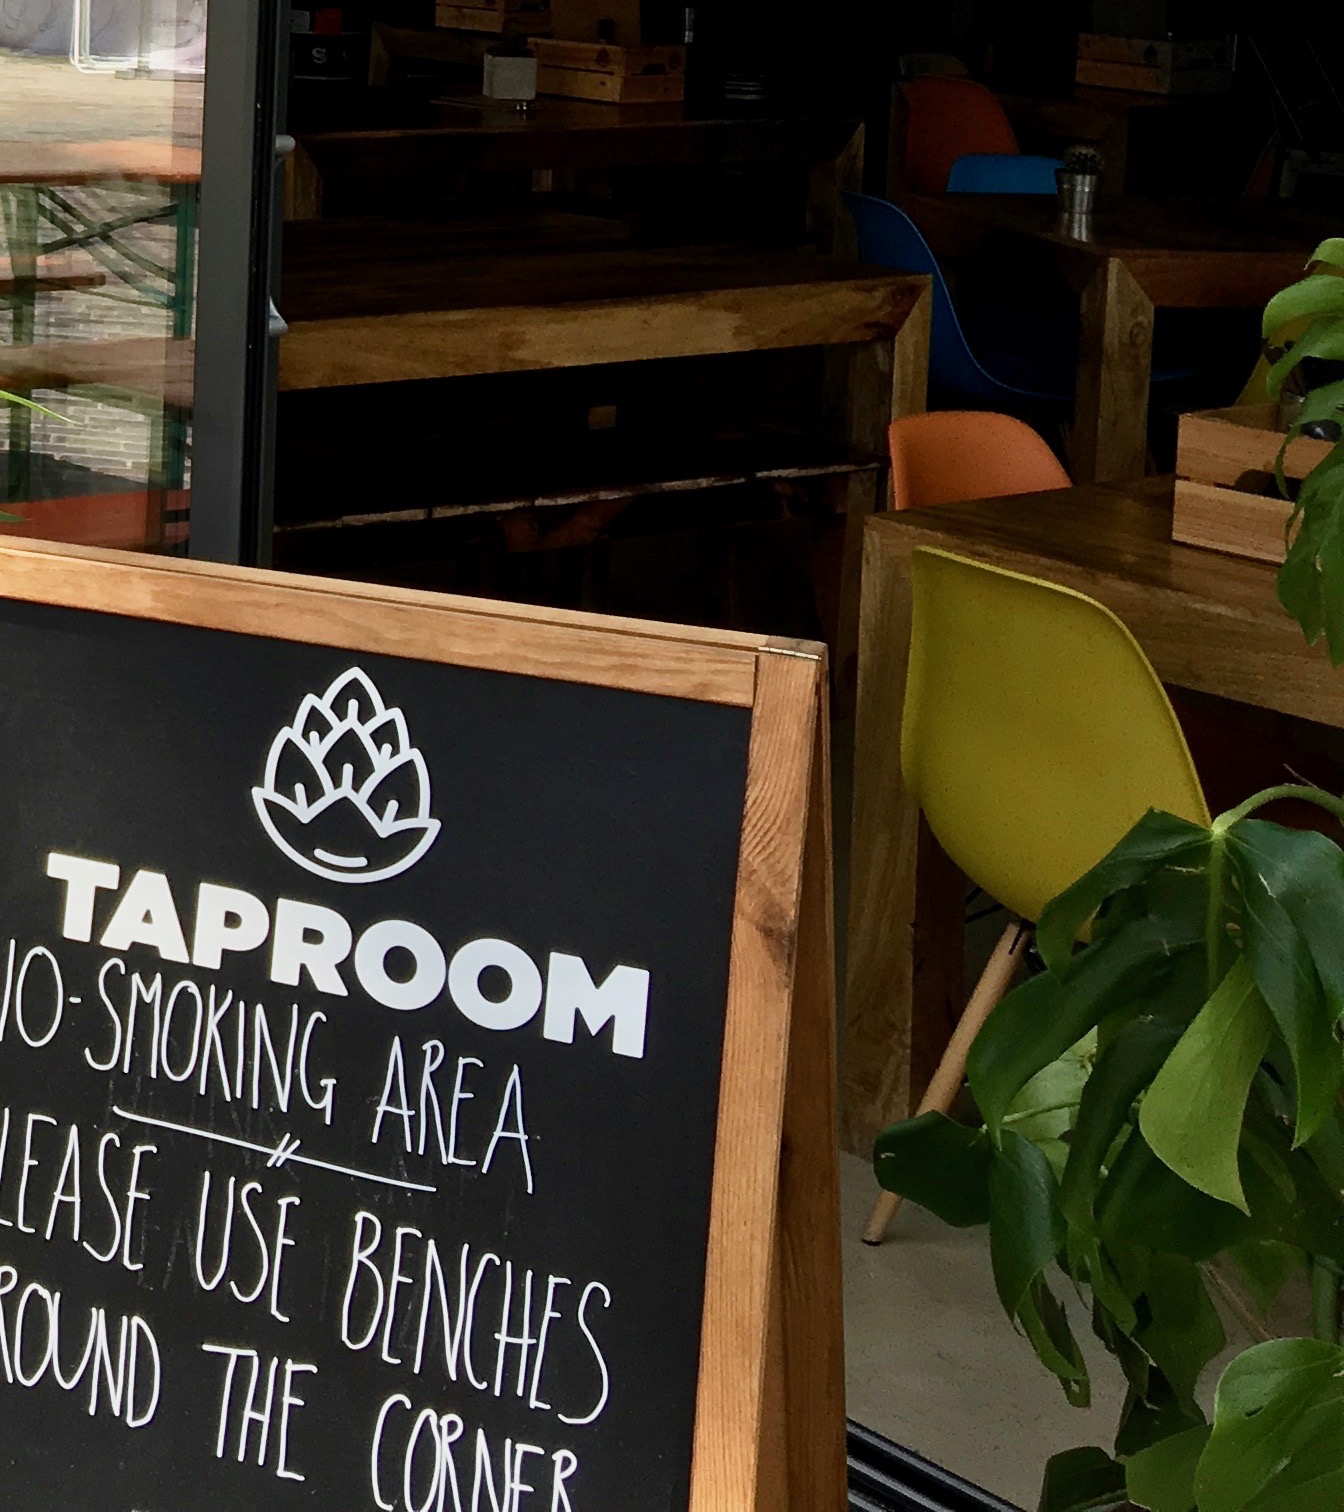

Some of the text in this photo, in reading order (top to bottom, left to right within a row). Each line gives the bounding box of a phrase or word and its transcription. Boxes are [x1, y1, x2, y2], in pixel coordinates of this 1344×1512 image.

[46, 852, 650, 1059] TAPROOM
[371, 1035, 534, 1195] AREA
[195, 1170, 301, 1324] USE
[341, 1210, 611, 1426] BENCHES
[201, 1343, 319, 1482] THE
